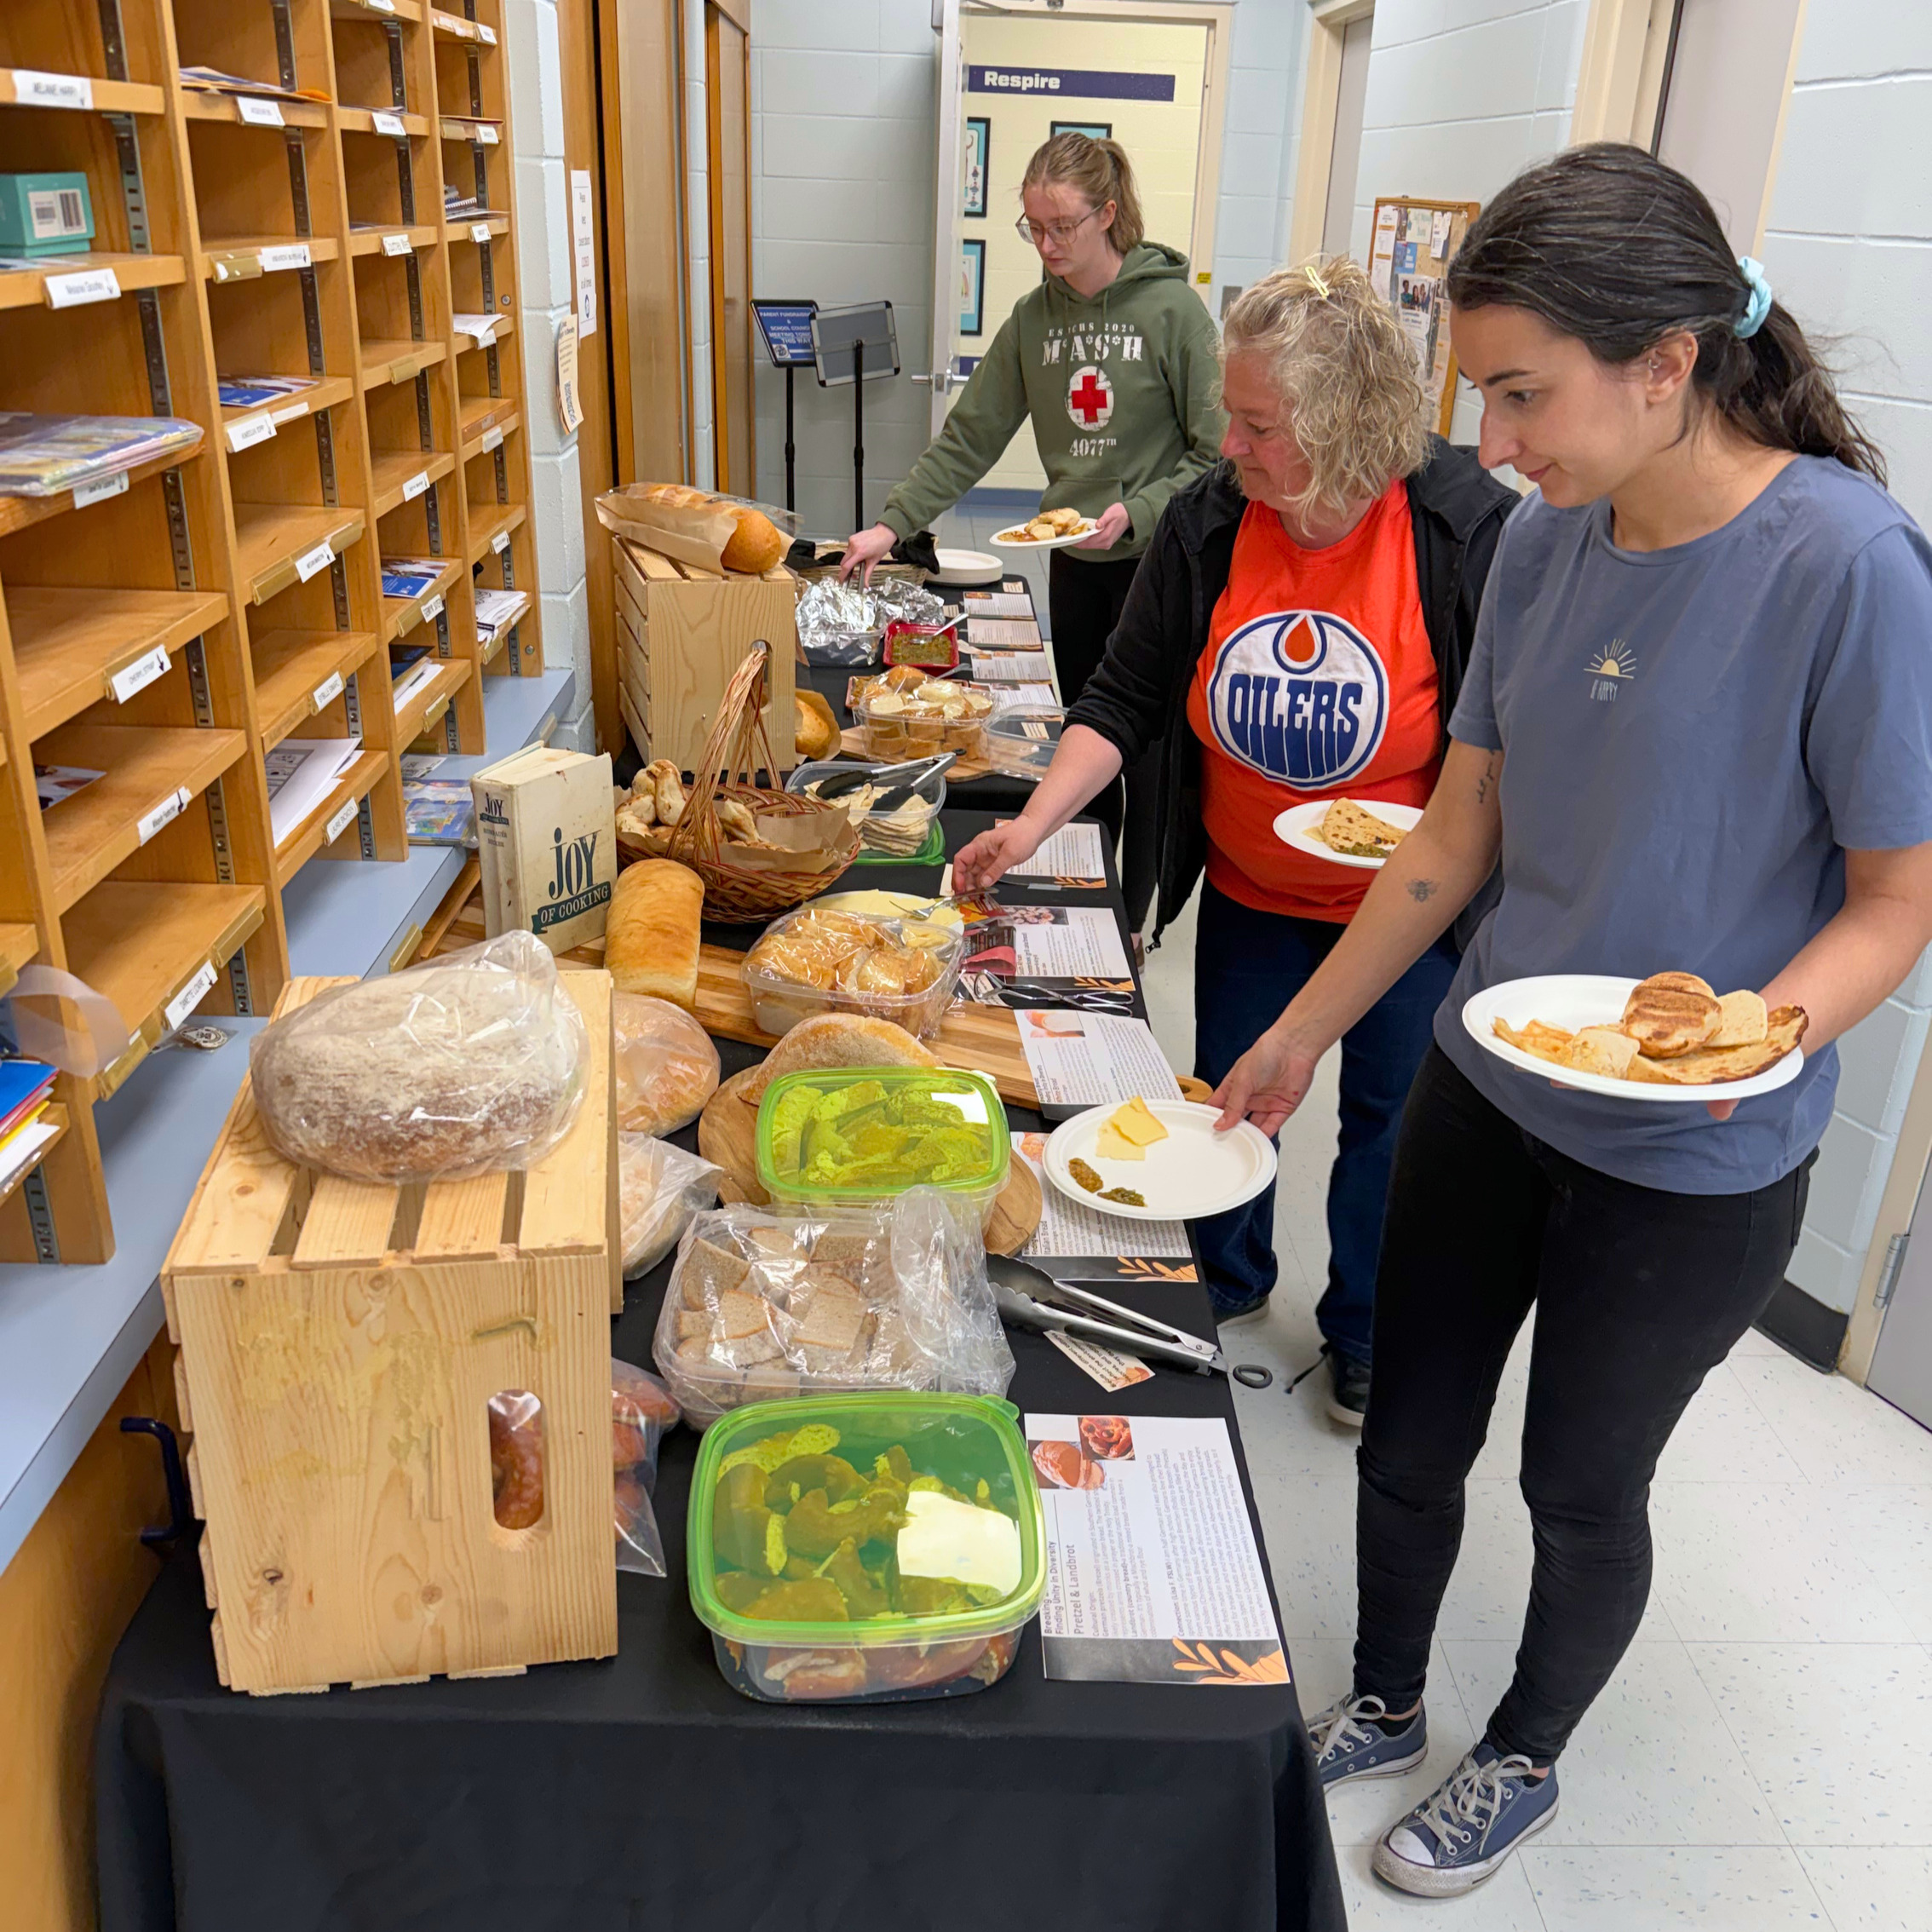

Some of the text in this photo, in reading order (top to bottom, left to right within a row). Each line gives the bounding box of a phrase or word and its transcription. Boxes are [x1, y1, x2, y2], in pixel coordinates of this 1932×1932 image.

[985, 71, 1061, 89] Respire
[1105, 323, 1135, 333] 2020
[1228, 673, 1363, 779] OILERS
[485, 793, 503, 818] JOY
[549, 827, 602, 900] JOY
[541, 885, 609, 924] OF COOKING
[1035, 1064, 1045, 1078] Diversity
[1049, 1078, 1060, 1090] Bread
[1038, 1220, 1051, 1254] Italian Bread
[1051, 1332, 1070, 1349] cultures
[1068, 1348, 1089, 1366] different
[1095, 1360, 1103, 1368] the
[1101, 1356, 1112, 1366] and
[1113, 1355, 1124, 1366] they
[1089, 1365, 1100, 1375] from
[1047, 1541, 1060, 1573] Diversity
[1064, 1544, 1079, 1587] Landbrot
[1051, 1584, 1062, 1604] Unity
[1041, 1599, 1054, 1633] Breaking
[1053, 1605, 1066, 1634] Finding
[1069, 1599, 1084, 1634] Pretzel
